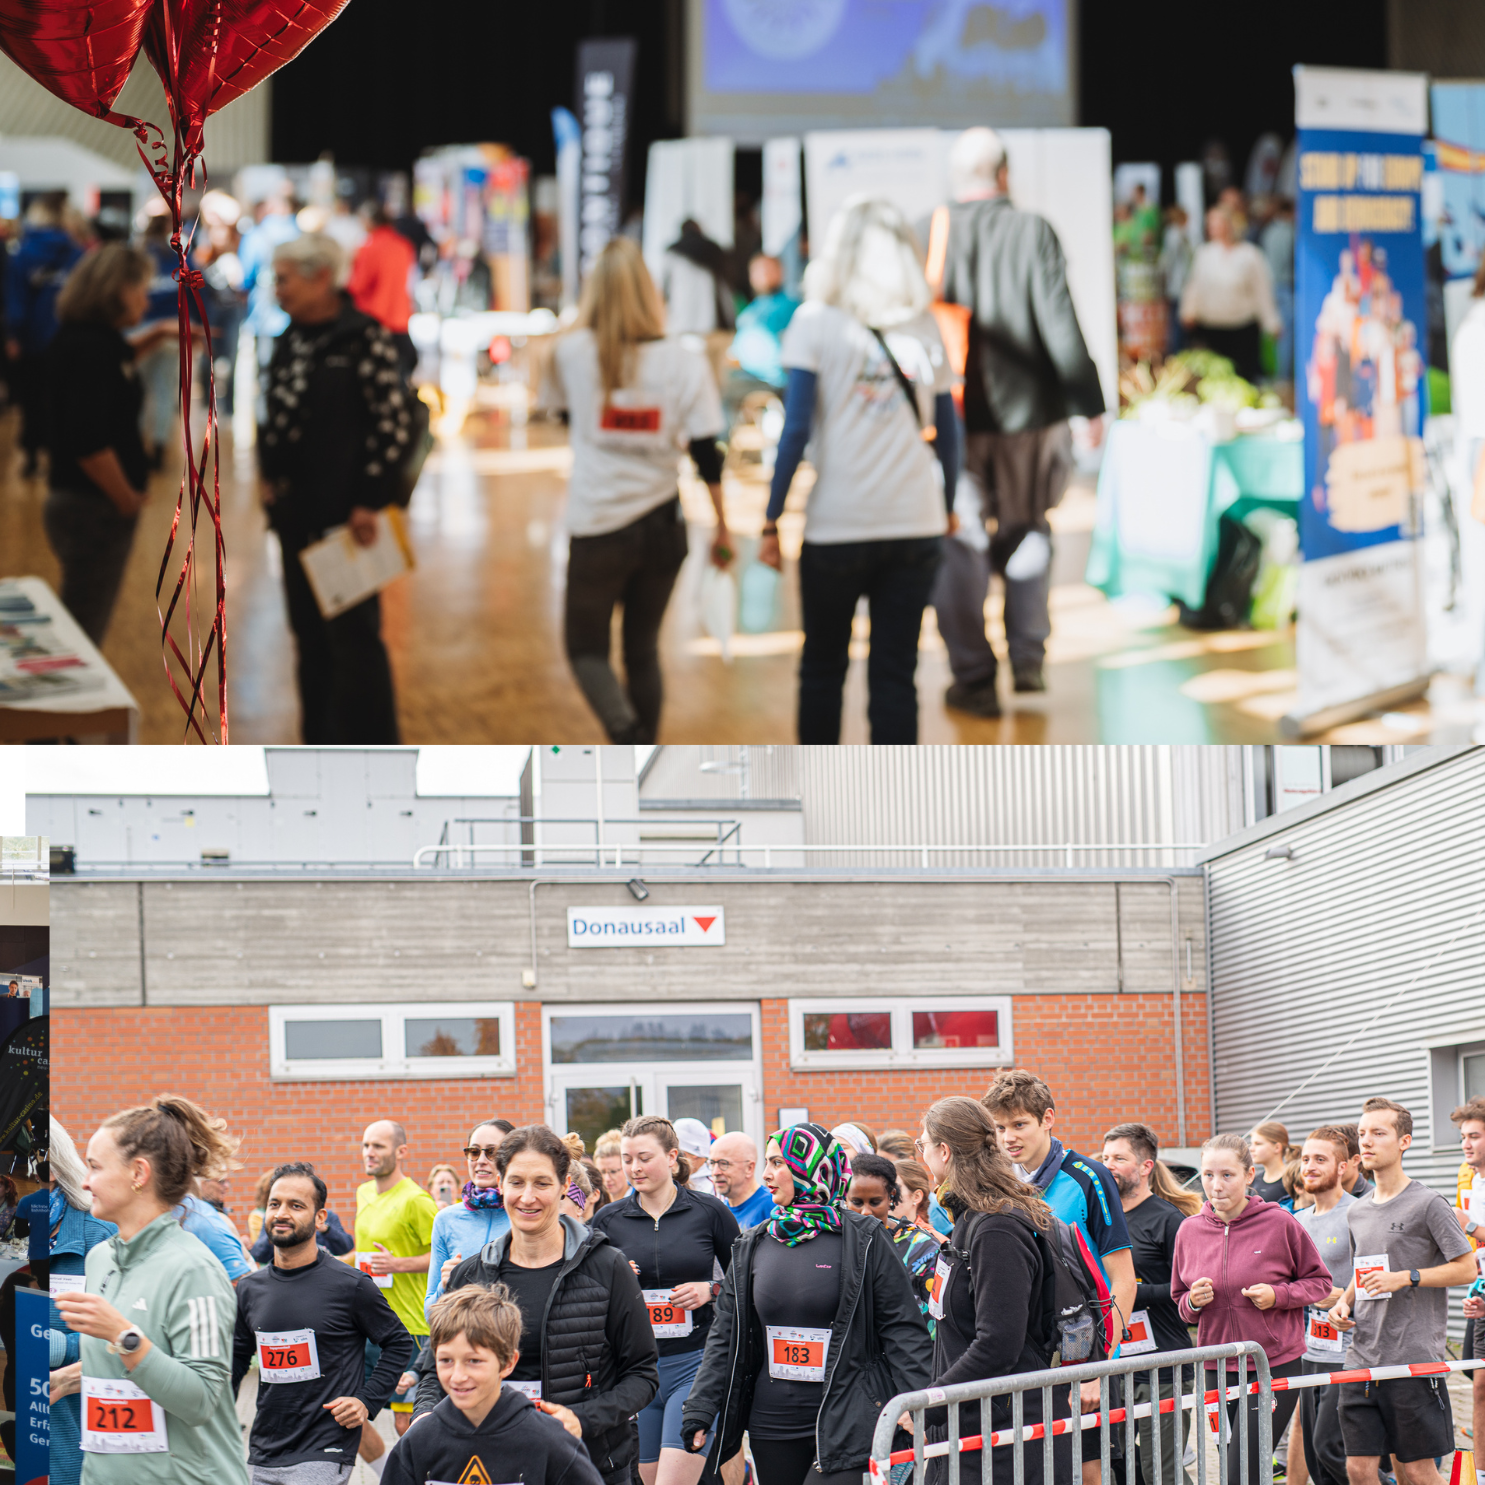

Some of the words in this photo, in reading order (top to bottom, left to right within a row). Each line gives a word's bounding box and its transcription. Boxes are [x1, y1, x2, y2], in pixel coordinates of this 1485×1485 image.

[572, 916, 686, 936] Donausaal
[8, 1044, 43, 1058] kultur
[268, 1350, 298, 1367] 276
[783, 1346, 810, 1363] 183
[95, 1406, 137, 1430] 212
